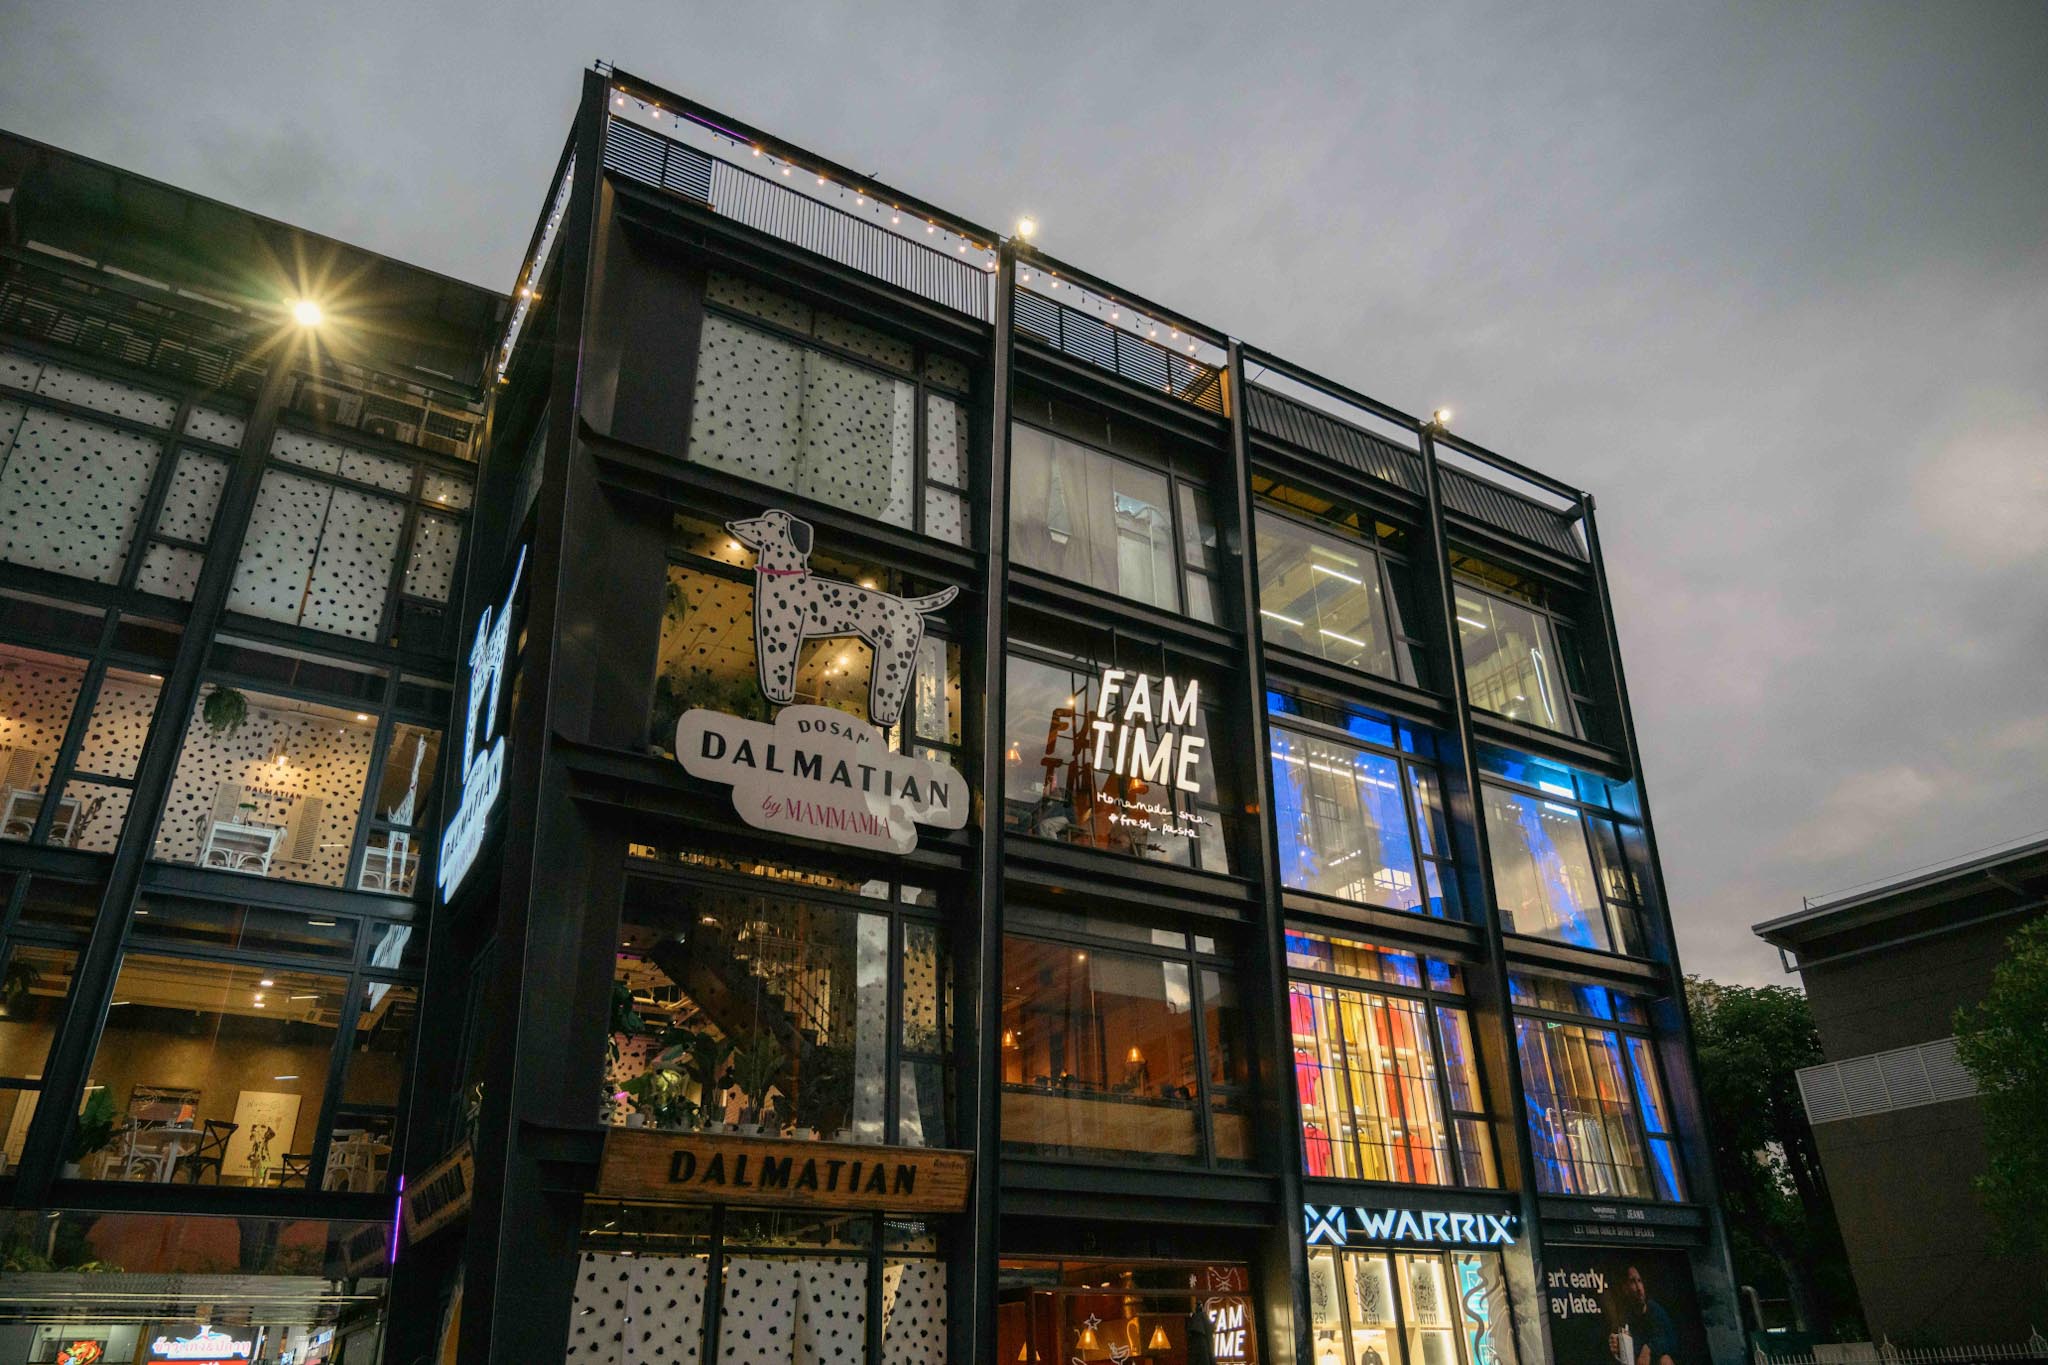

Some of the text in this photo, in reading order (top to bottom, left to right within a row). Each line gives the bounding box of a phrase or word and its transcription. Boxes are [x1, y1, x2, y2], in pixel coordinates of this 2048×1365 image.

[1097, 670, 1199, 727] FAM
[798, 720, 869, 744] DOSAN
[701, 730, 948, 808] DALMATIAN
[1092, 721, 1205, 793] TIME
[245, 785, 301, 800] DALMATIAN
[762, 795, 891, 839] by MAMMAMIA
[668, 1150, 917, 1196] DALMATIAN
[1354, 1207, 1517, 1244] WARRIX
[1548, 1268, 1608, 1293] art early.
[1552, 1292, 1601, 1319] ay late.
[1213, 1329, 1246, 1357] IME
